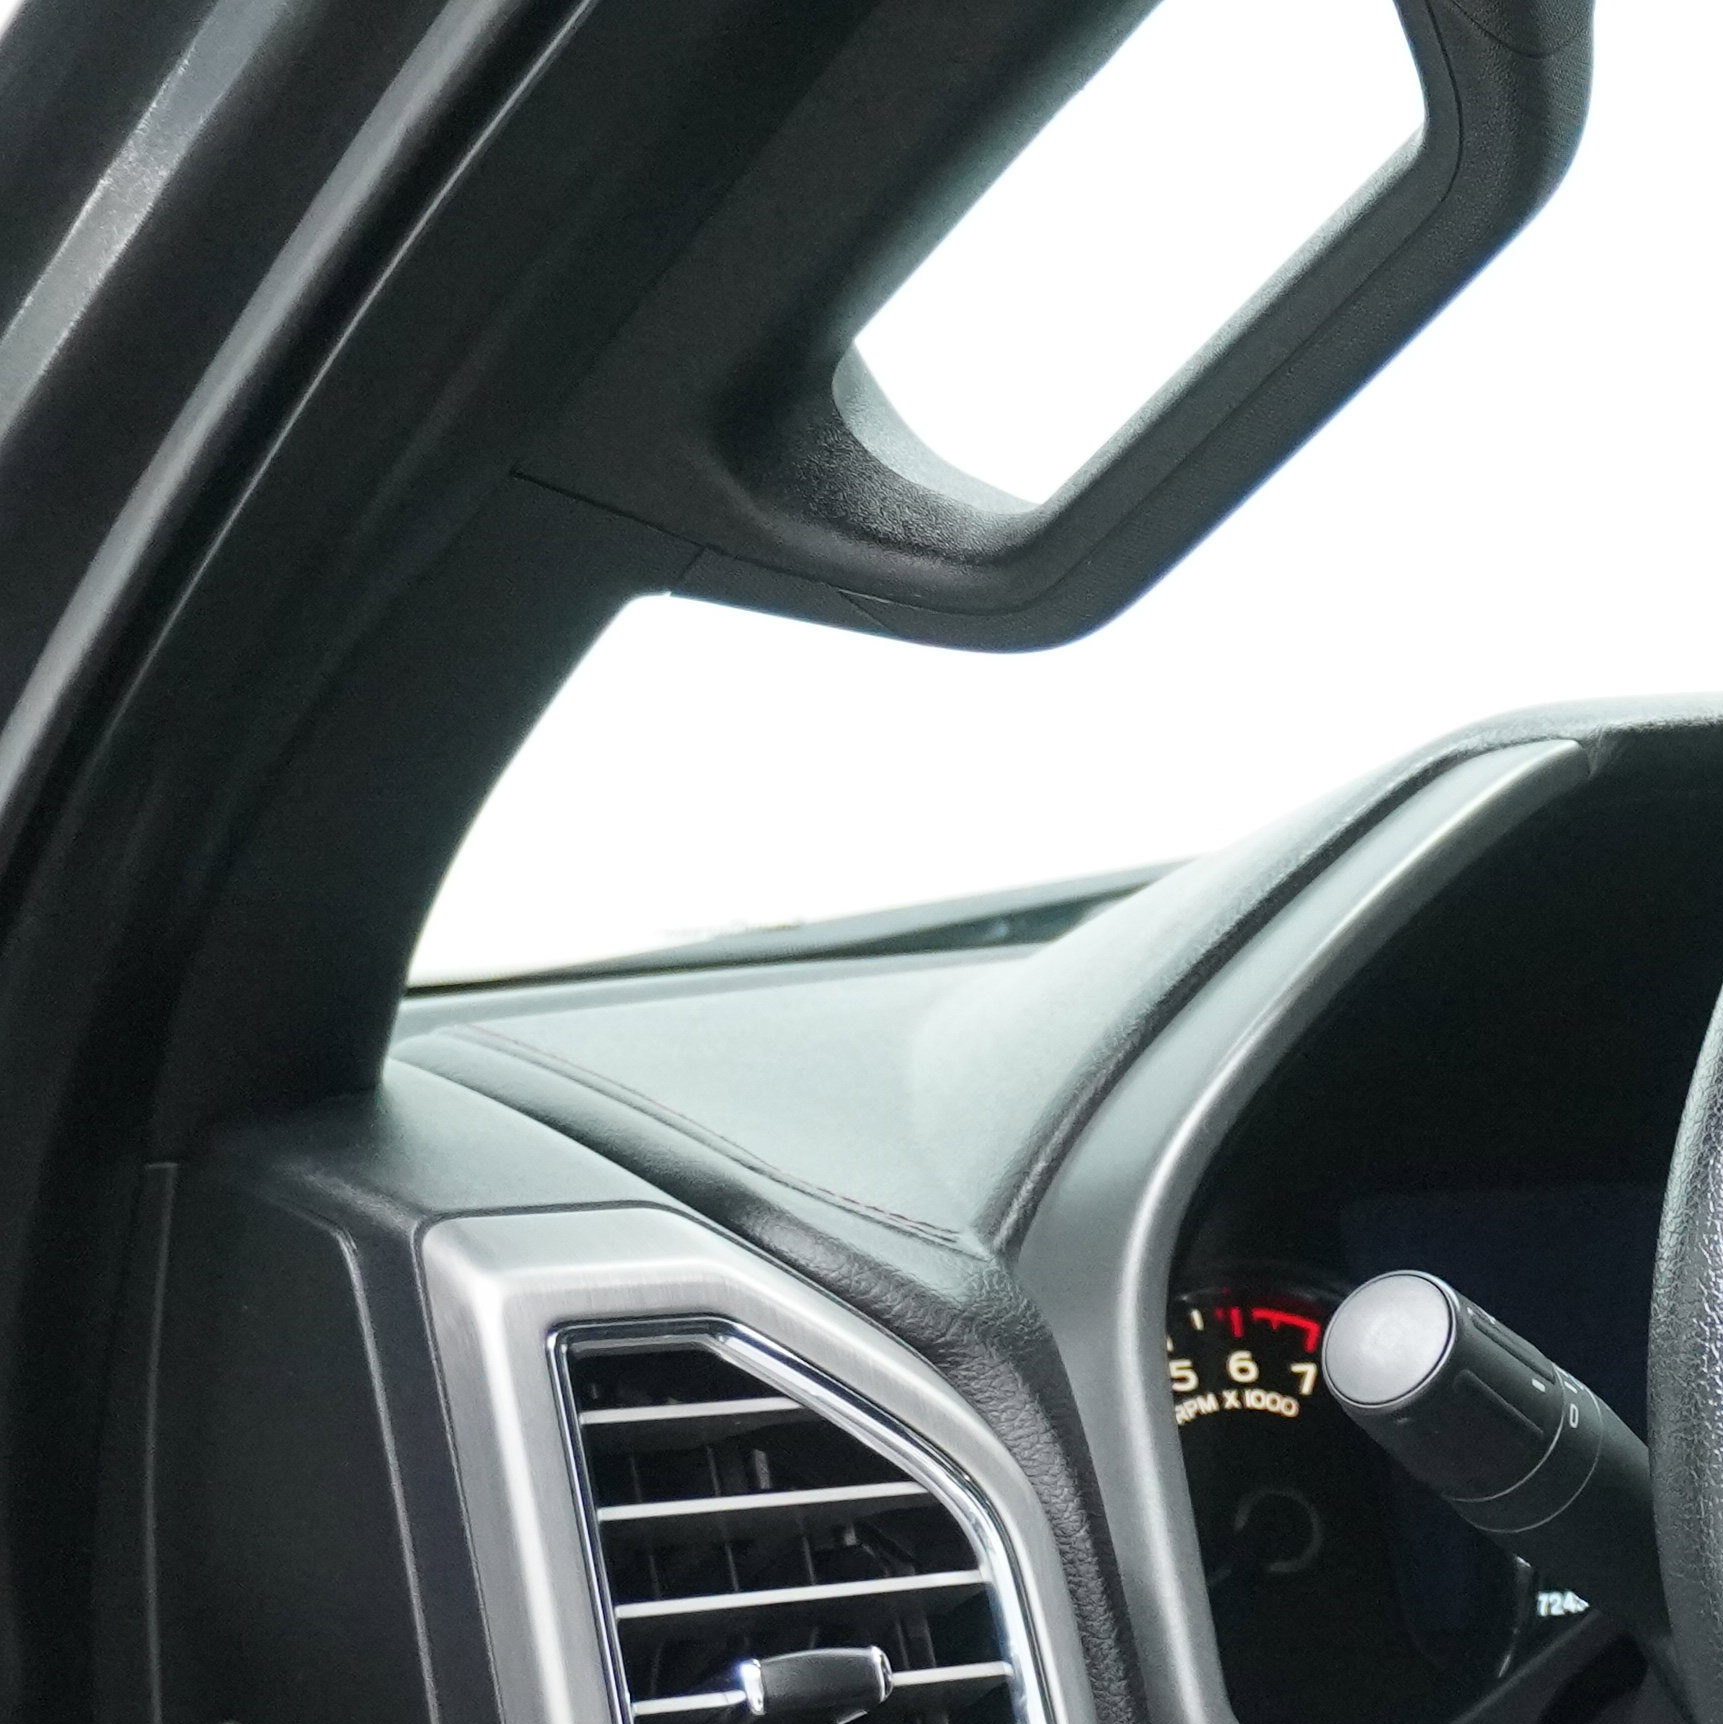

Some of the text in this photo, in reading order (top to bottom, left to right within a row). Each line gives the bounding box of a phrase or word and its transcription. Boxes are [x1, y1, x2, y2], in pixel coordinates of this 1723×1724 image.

[1168, 1350, 1318, 1396] 5 6 7
[1222, 1388, 1243, 1410] X
[1245, 1387, 1300, 1418] 1000
